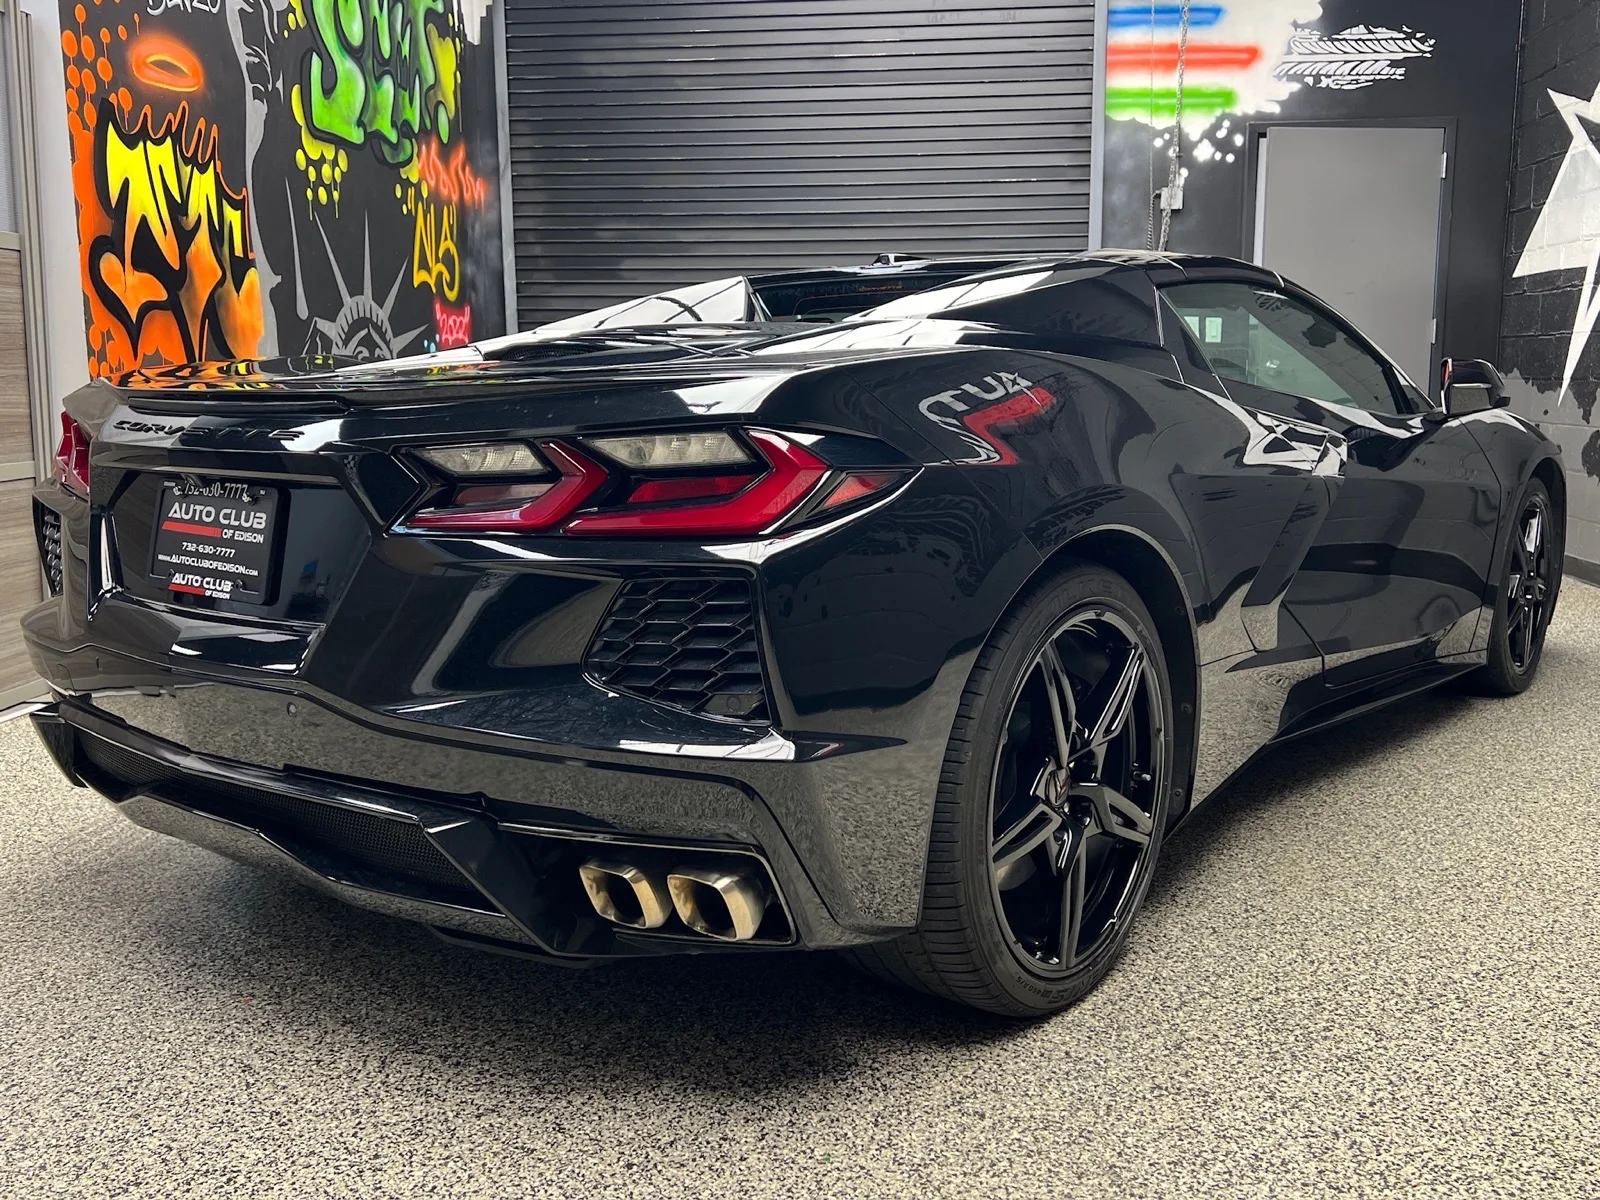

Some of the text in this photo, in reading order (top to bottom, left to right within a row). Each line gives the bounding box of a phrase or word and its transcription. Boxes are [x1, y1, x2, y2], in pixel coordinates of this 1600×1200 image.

[113, 420, 305, 442] CORVETTE
[168, 502, 267, 529] AUTO CLUB
[222, 529, 264, 543] OF EDISON
[181, 542, 235, 557] 732-630-7777
[171, 573, 233, 592] AUTO CLUB
[205, 589, 231, 600] OF EDISON
